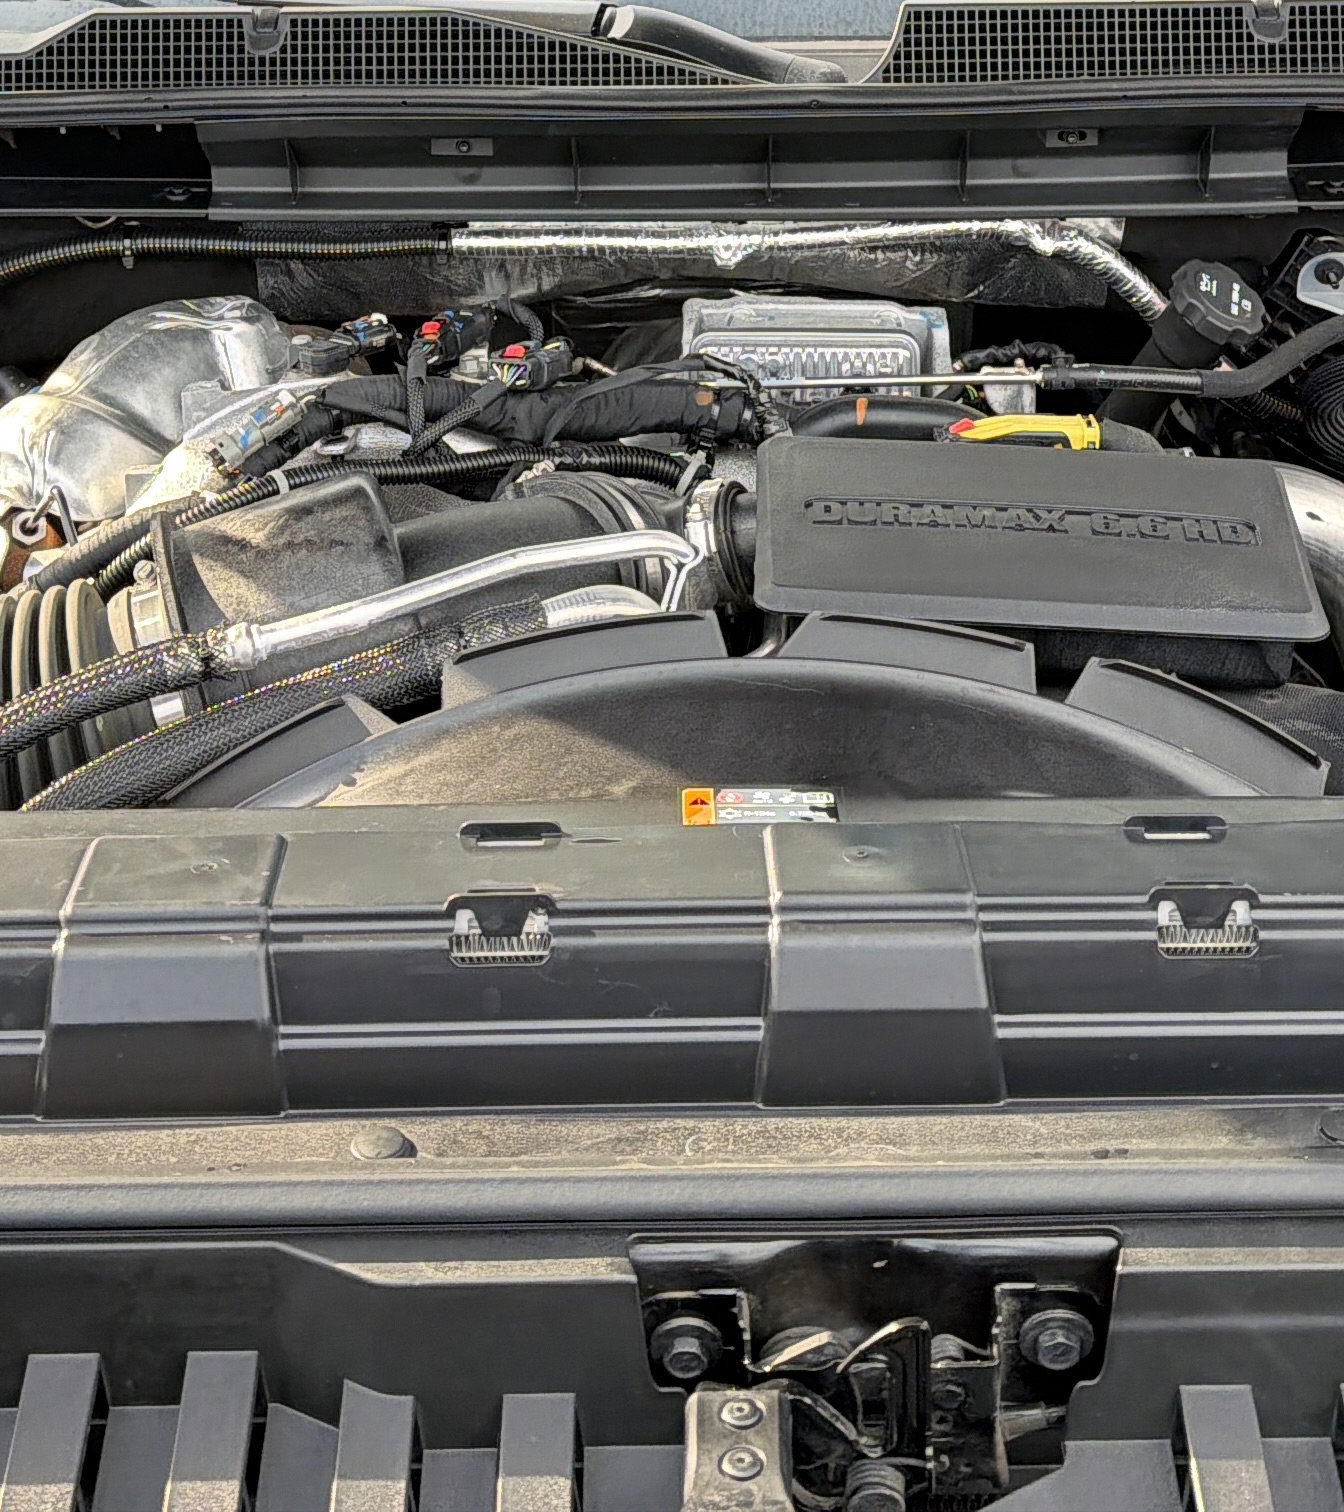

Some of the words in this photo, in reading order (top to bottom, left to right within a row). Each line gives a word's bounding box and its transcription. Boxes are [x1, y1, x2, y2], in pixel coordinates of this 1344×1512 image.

[811, 500, 1069, 534] DURAMAX
[1090, 511, 1170, 541] 6.6
[1183, 517, 1256, 546] HD
